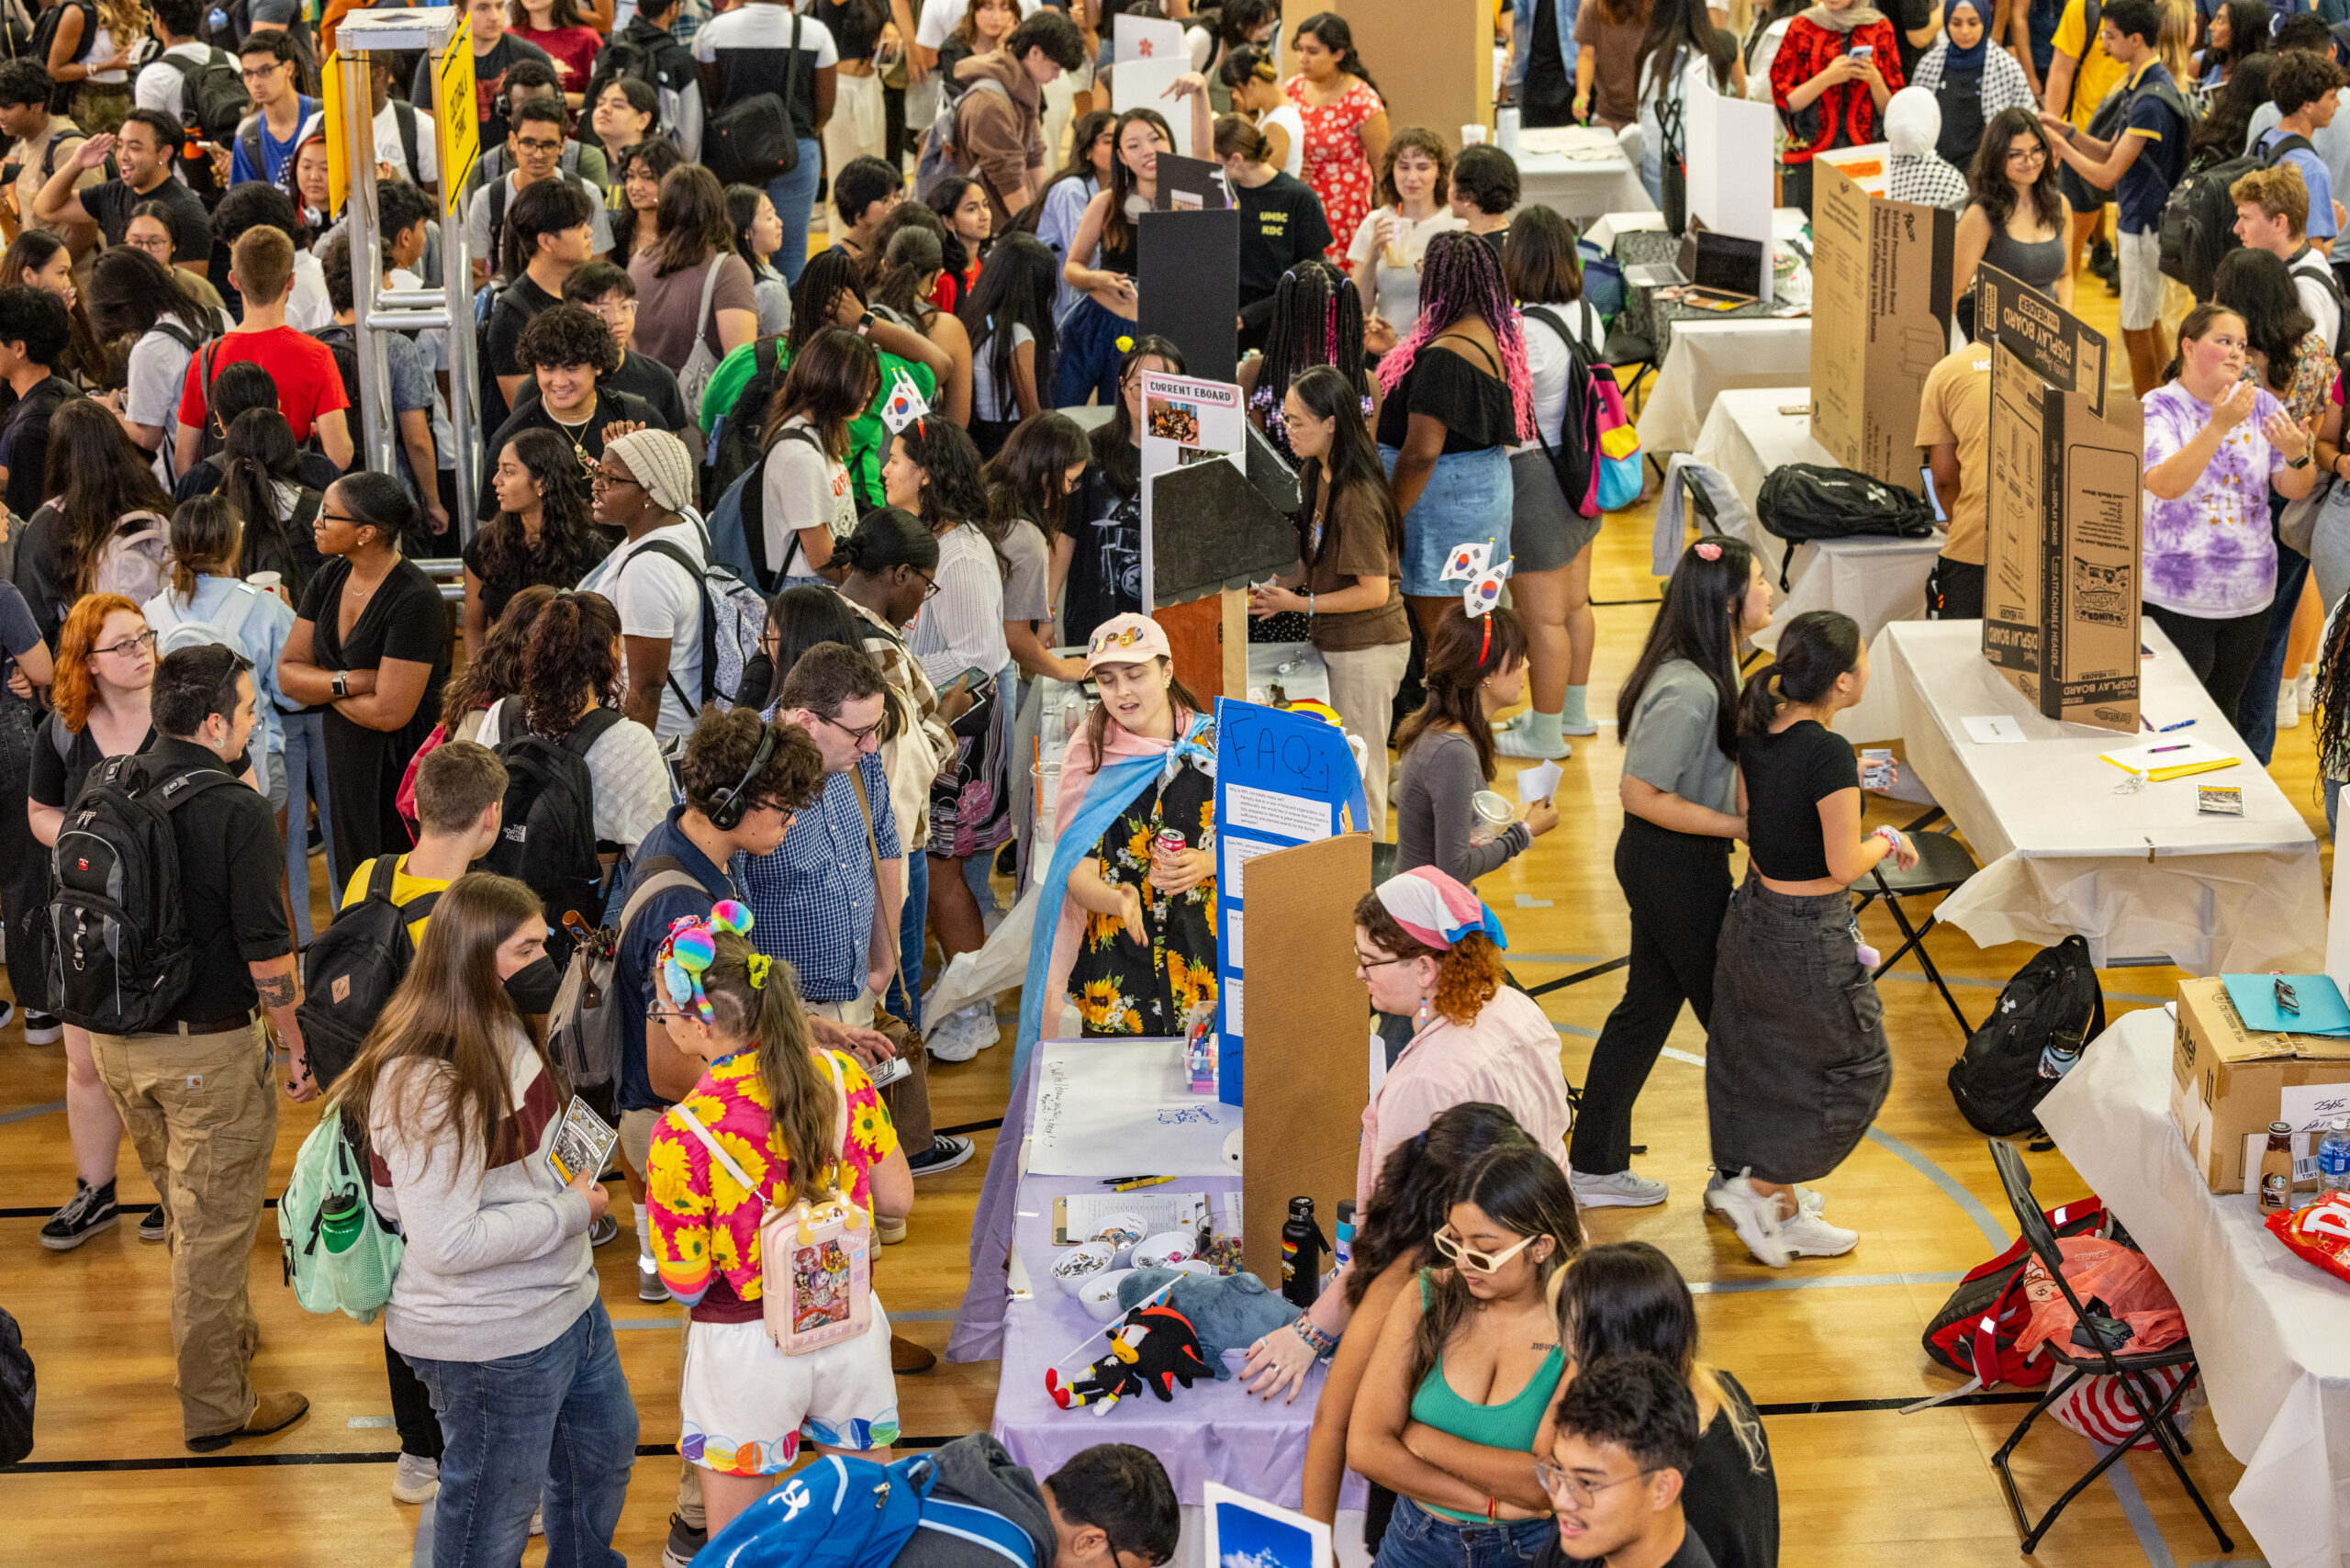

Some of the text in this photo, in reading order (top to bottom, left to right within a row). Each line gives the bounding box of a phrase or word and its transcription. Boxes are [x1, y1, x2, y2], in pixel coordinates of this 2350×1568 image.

[1259, 211, 1289, 223] UMBC
[1261, 225, 1284, 237] KDC
[1890, 240, 1898, 289] Presentation
[1889, 291, 1897, 315] Board
[2020, 297, 2049, 323] HEADER
[2003, 307, 2035, 341] BOARD
[2036, 327, 2072, 364] DISPLAY
[1150, 382, 1231, 401] CURRENT EBOARD
[2051, 574, 2059, 666] ATTACHABLE HEADER
[1988, 627, 2038, 651] DISPLAY BOARD
[2064, 679, 2137, 696] DISPLAY BOARD
[2081, 673, 2108, 681] HEADER
[506, 834, 522, 842] FACE
[2177, 1010, 2197, 1066] bullet
[2074, 1249, 2109, 1262] SEAWEED
